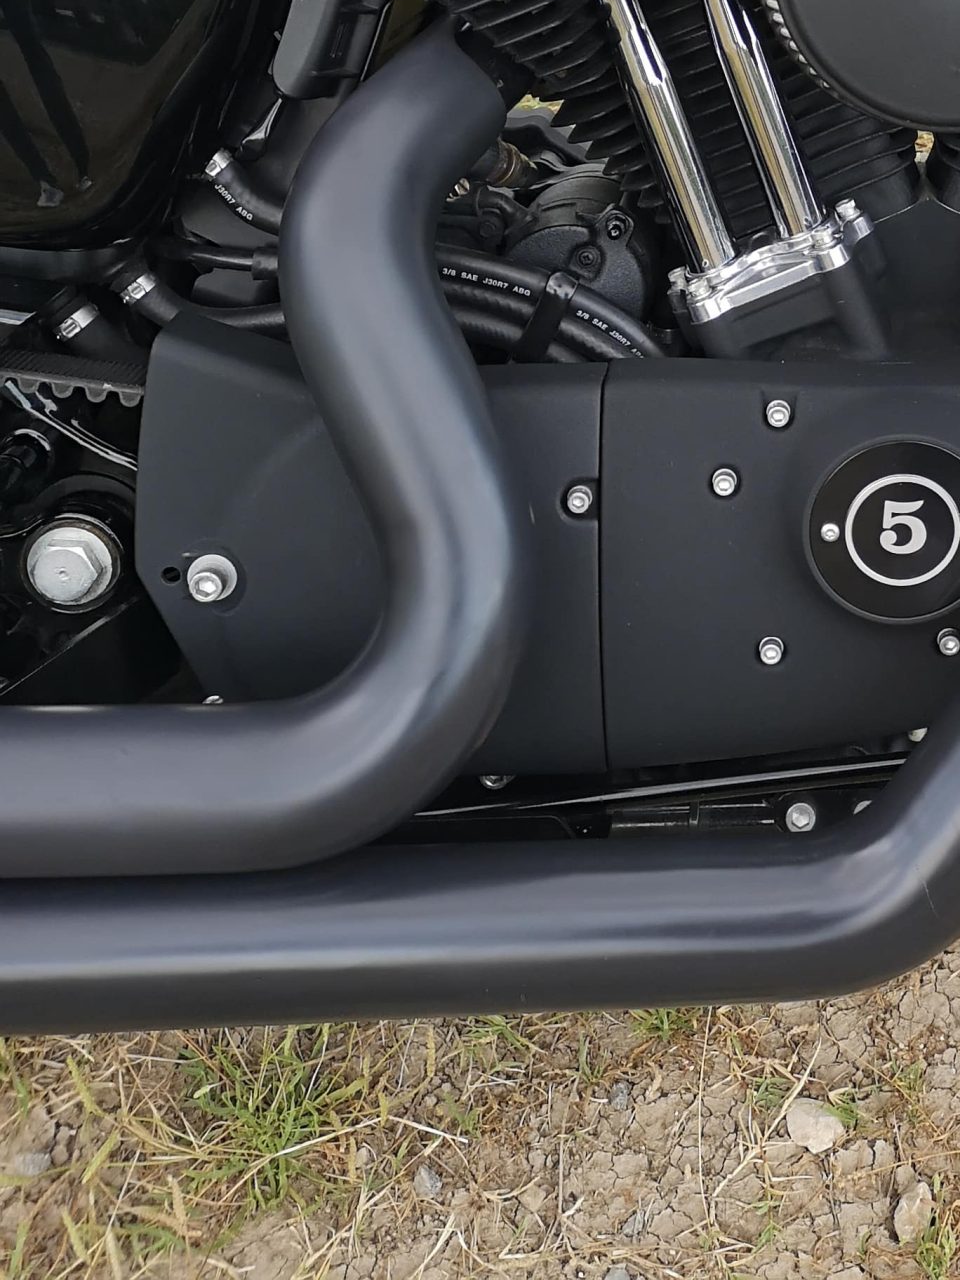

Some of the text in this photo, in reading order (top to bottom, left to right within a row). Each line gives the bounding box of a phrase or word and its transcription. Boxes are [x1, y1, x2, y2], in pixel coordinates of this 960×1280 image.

[214, 184, 236, 204] J30R7
[442, 267, 456, 277] 3/8
[461, 271, 479, 282] SAE
[482, 277, 509, 289] J30R7
[592, 318, 609, 331] SAE
[609, 330, 631, 346] J30R7
[879, 500, 917, 554] 5
